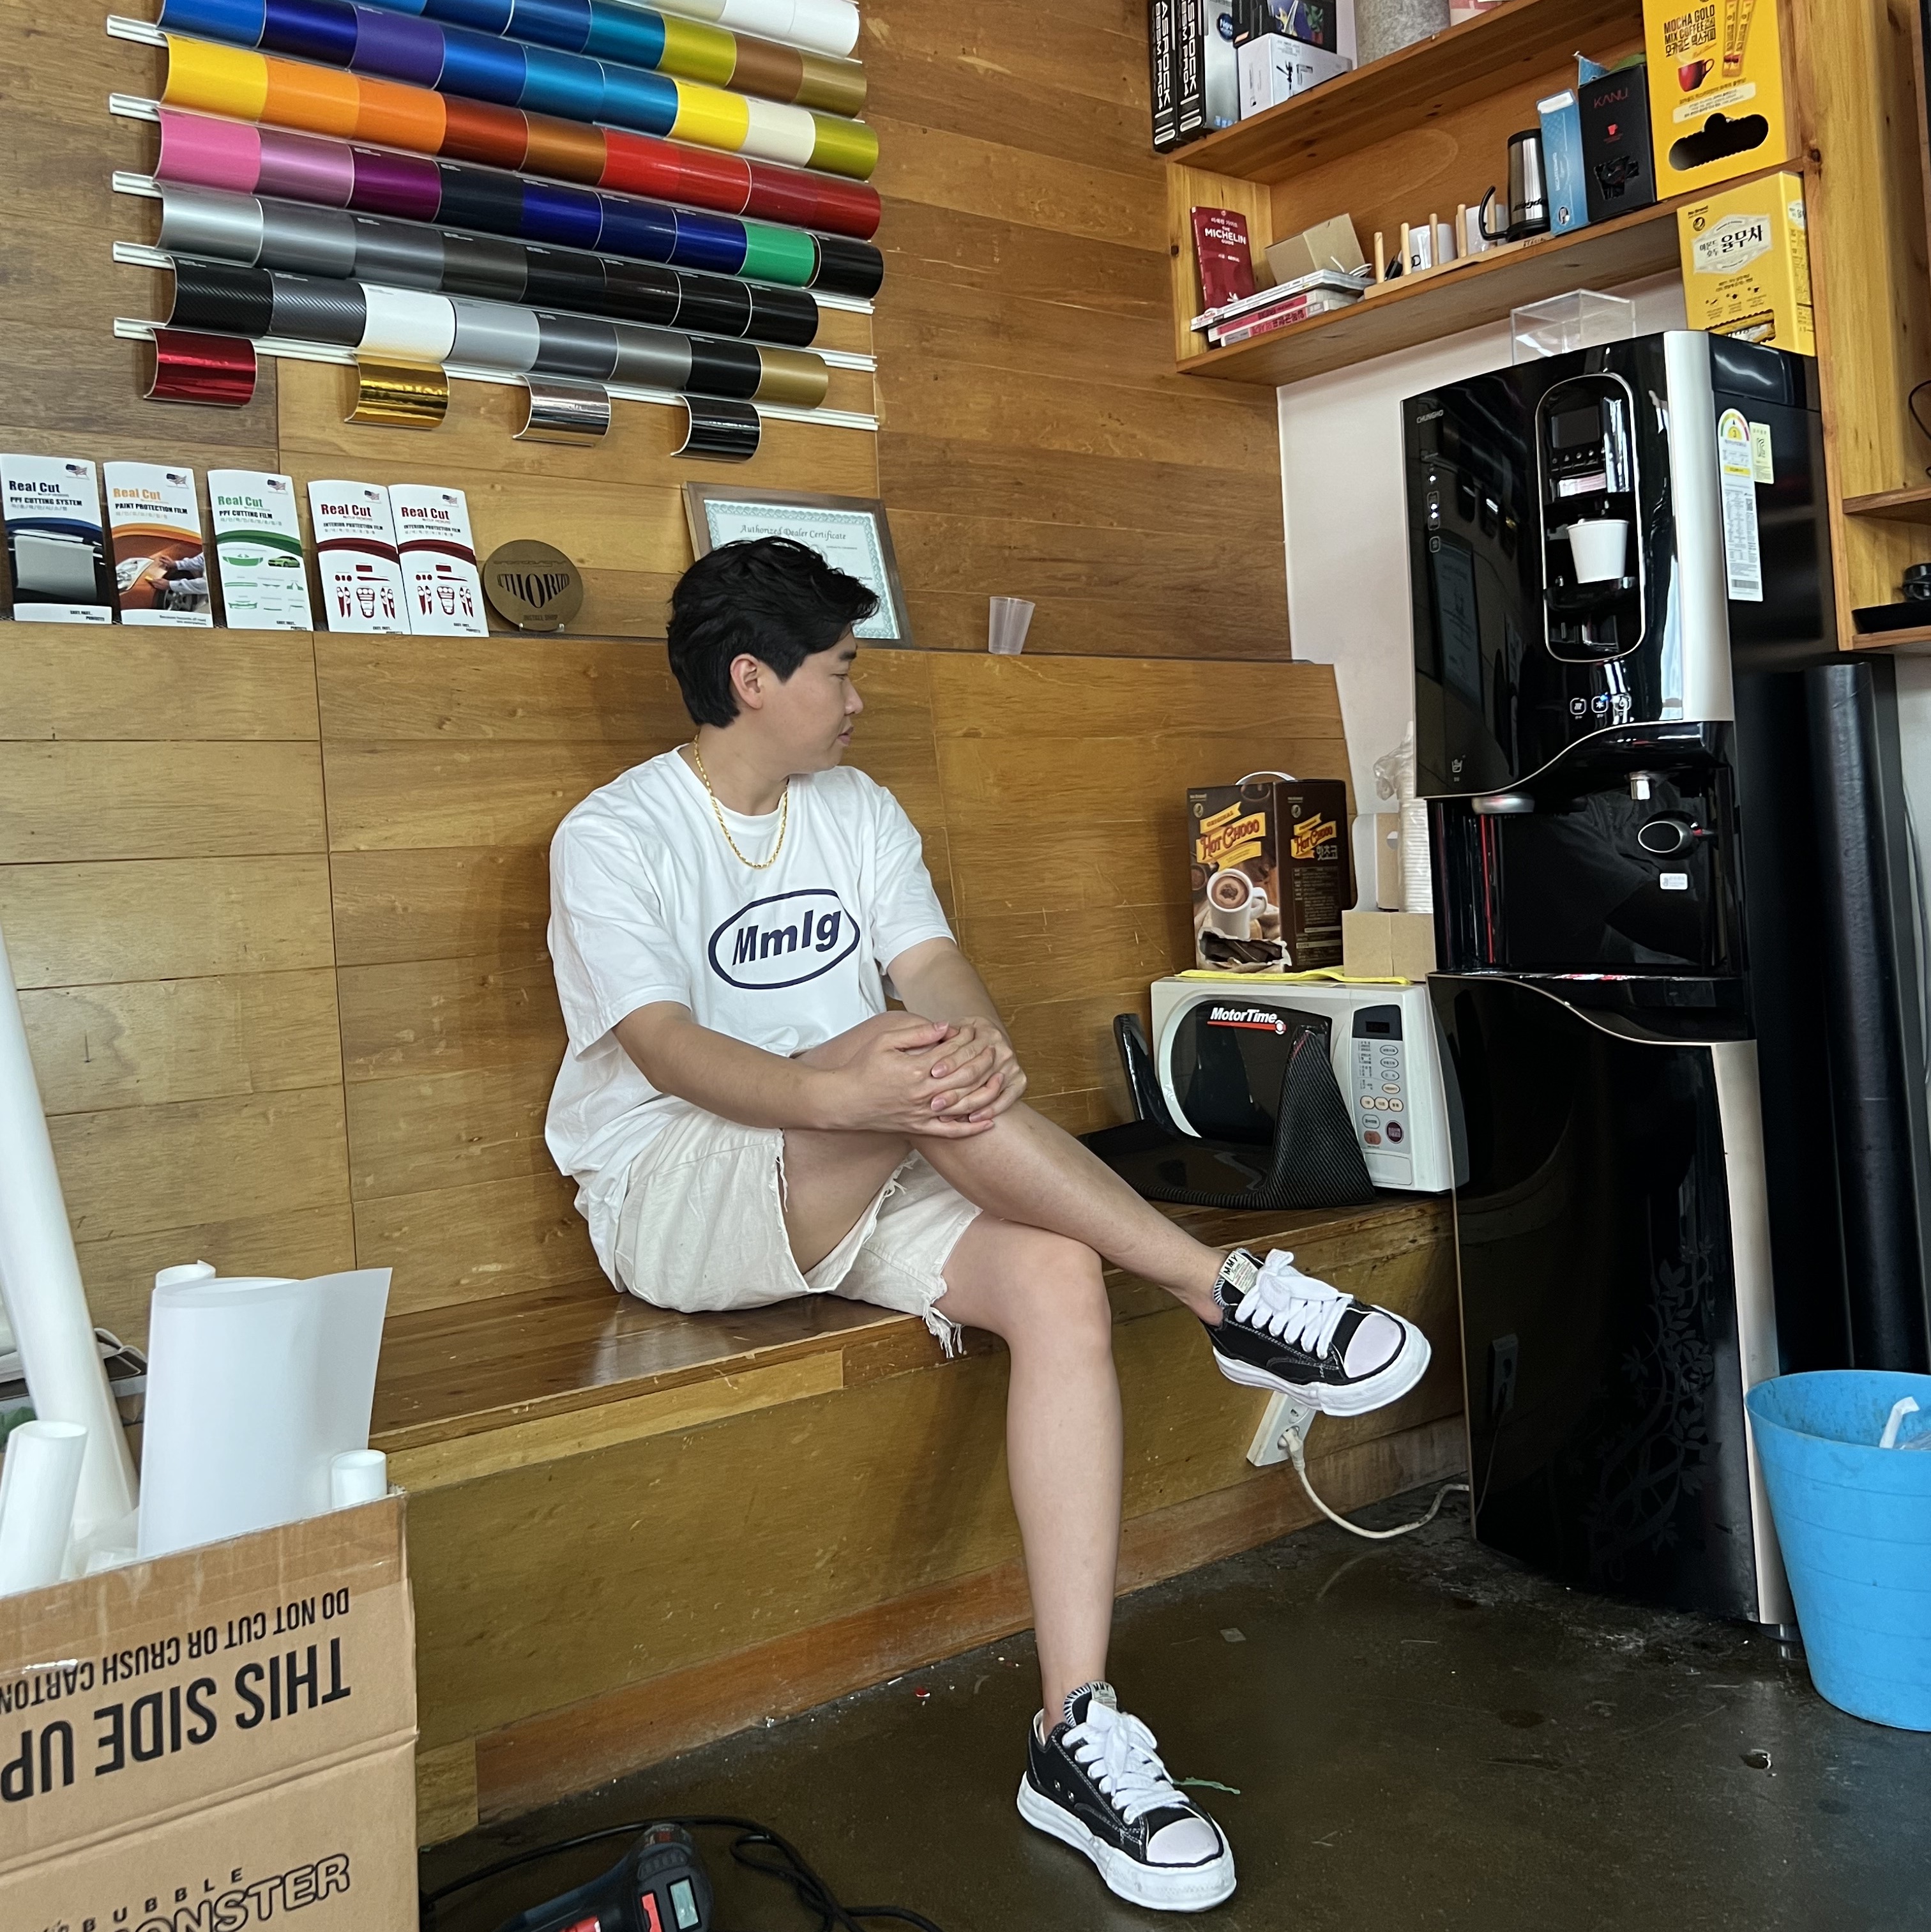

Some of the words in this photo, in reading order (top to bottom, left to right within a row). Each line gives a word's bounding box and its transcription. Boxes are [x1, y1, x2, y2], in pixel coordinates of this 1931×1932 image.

[1663, 12, 1693, 34] MOCHA
[1694, 4, 1715, 24] GOLD
[1664, 30, 1678, 45] MIX
[1679, 20, 1704, 40] COFFEE
[1162, 1, 1171, 107] ASROCK
[1188, 0, 1197, 93] SROCK
[1204, 227, 1246, 245] MICHELIN
[8, 480, 36, 492] Real
[39, 482, 61, 494] Cut
[24, 497, 55, 505] CUTTING
[56, 498, 83, 506] SYSTEM
[113, 487, 140, 499] Real
[142, 489, 162, 501] Cut
[217, 495, 243, 506] Real
[245, 496, 264, 508] Cut
[135, 503, 173, 513] PROTECTION
[321, 503, 349, 515] Real
[352, 504, 372, 518] Cut
[400, 506, 427, 518] Real
[430, 508, 450, 521] Cut
[740, 524, 783, 536] Authorized
[784, 527, 808, 538] Dealer
[809, 530, 846, 542] Certificate
[732, 909, 842, 966] Mmlg
[1210, 1007, 1278, 1024] MotorTime
[1223, 1254, 1238, 1276] MMY
[272, 1596, 316, 1636] NOT
[322, 1586, 351, 1622] DO
[188, 1625, 218, 1661] OR
[224, 1611, 267, 1652] CUT
[102, 1636, 181, 1687] CRUSH
[0, 1661, 95, 1715] CARTON
[234, 1636, 352, 1730] THIS
[93, 1677, 218, 1777] SIDE
[1, 1719, 75, 1803] UP
[82, 1866, 243, 1932] BUBBLE
